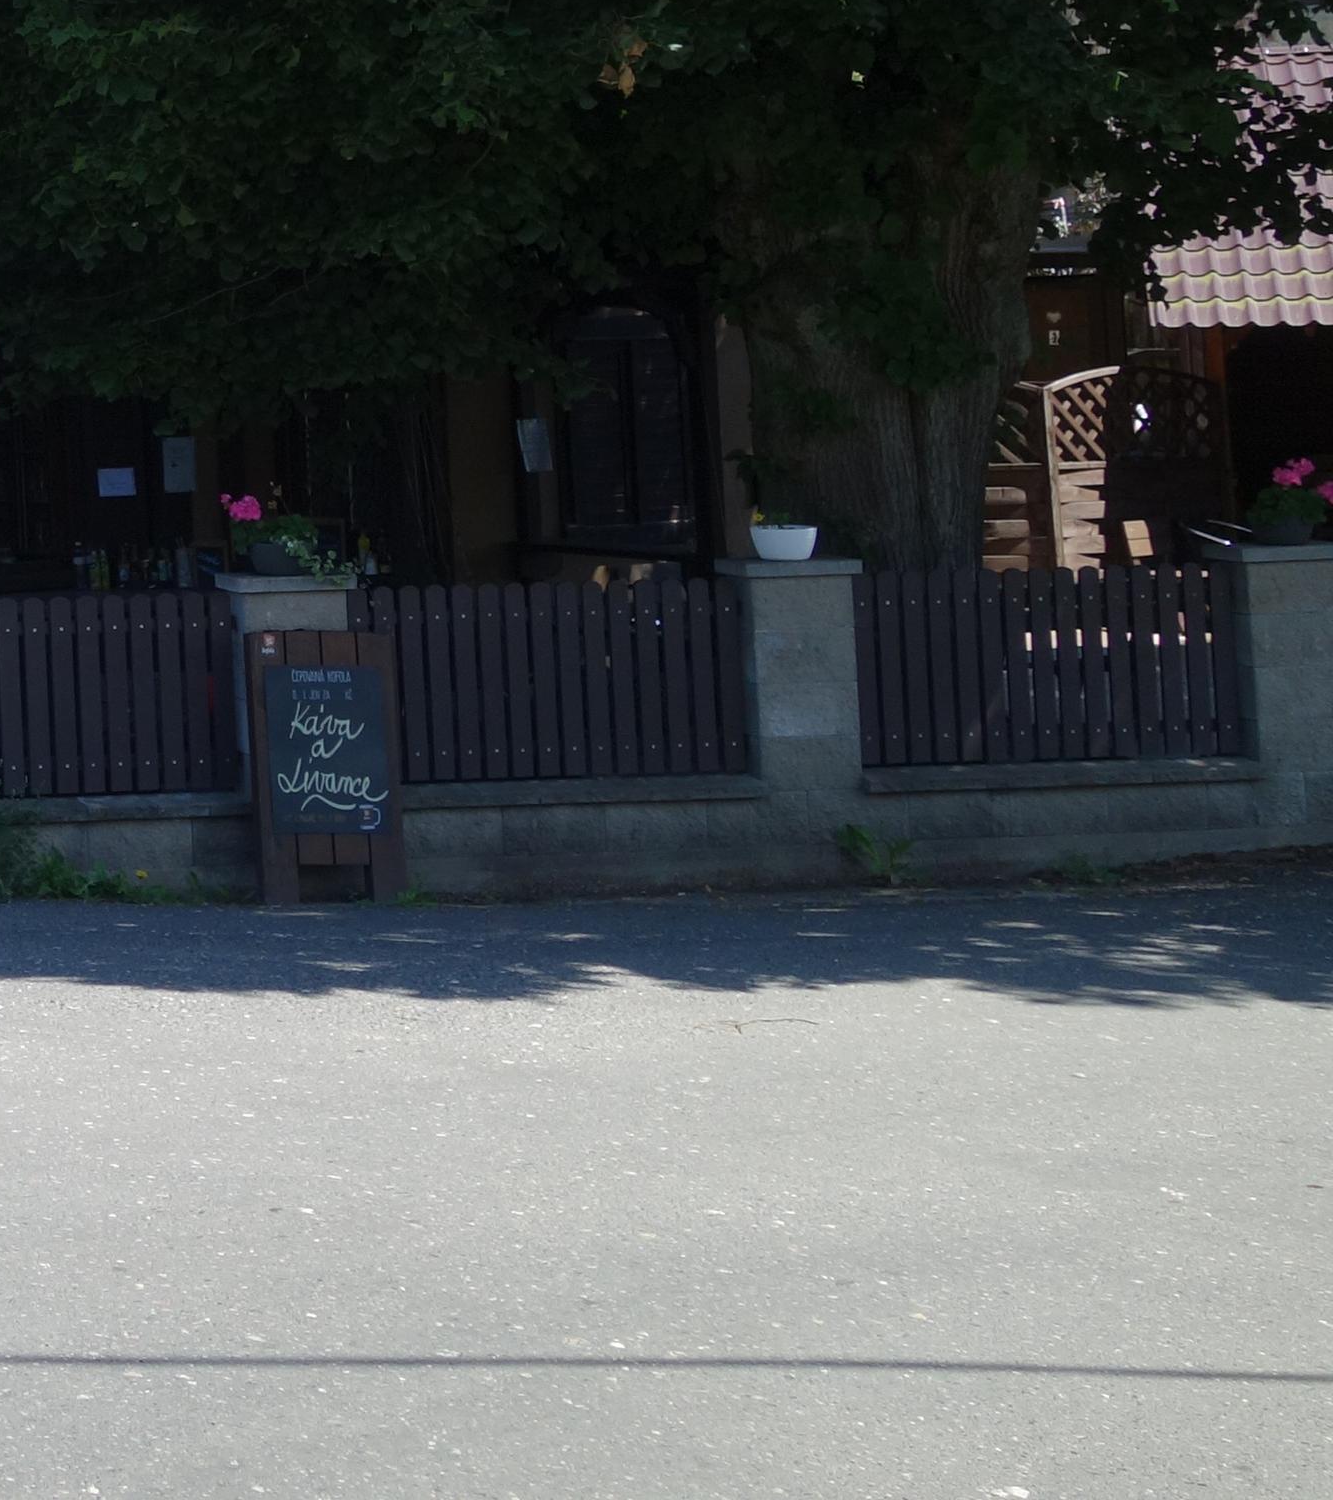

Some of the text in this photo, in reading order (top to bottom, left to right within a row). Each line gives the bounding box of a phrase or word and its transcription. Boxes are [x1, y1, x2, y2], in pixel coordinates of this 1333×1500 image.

[326, 669, 352, 683] KOFOLA
[289, 701, 365, 740] Káva
[311, 737, 343, 759] a
[277, 757, 390, 802] Lívance
